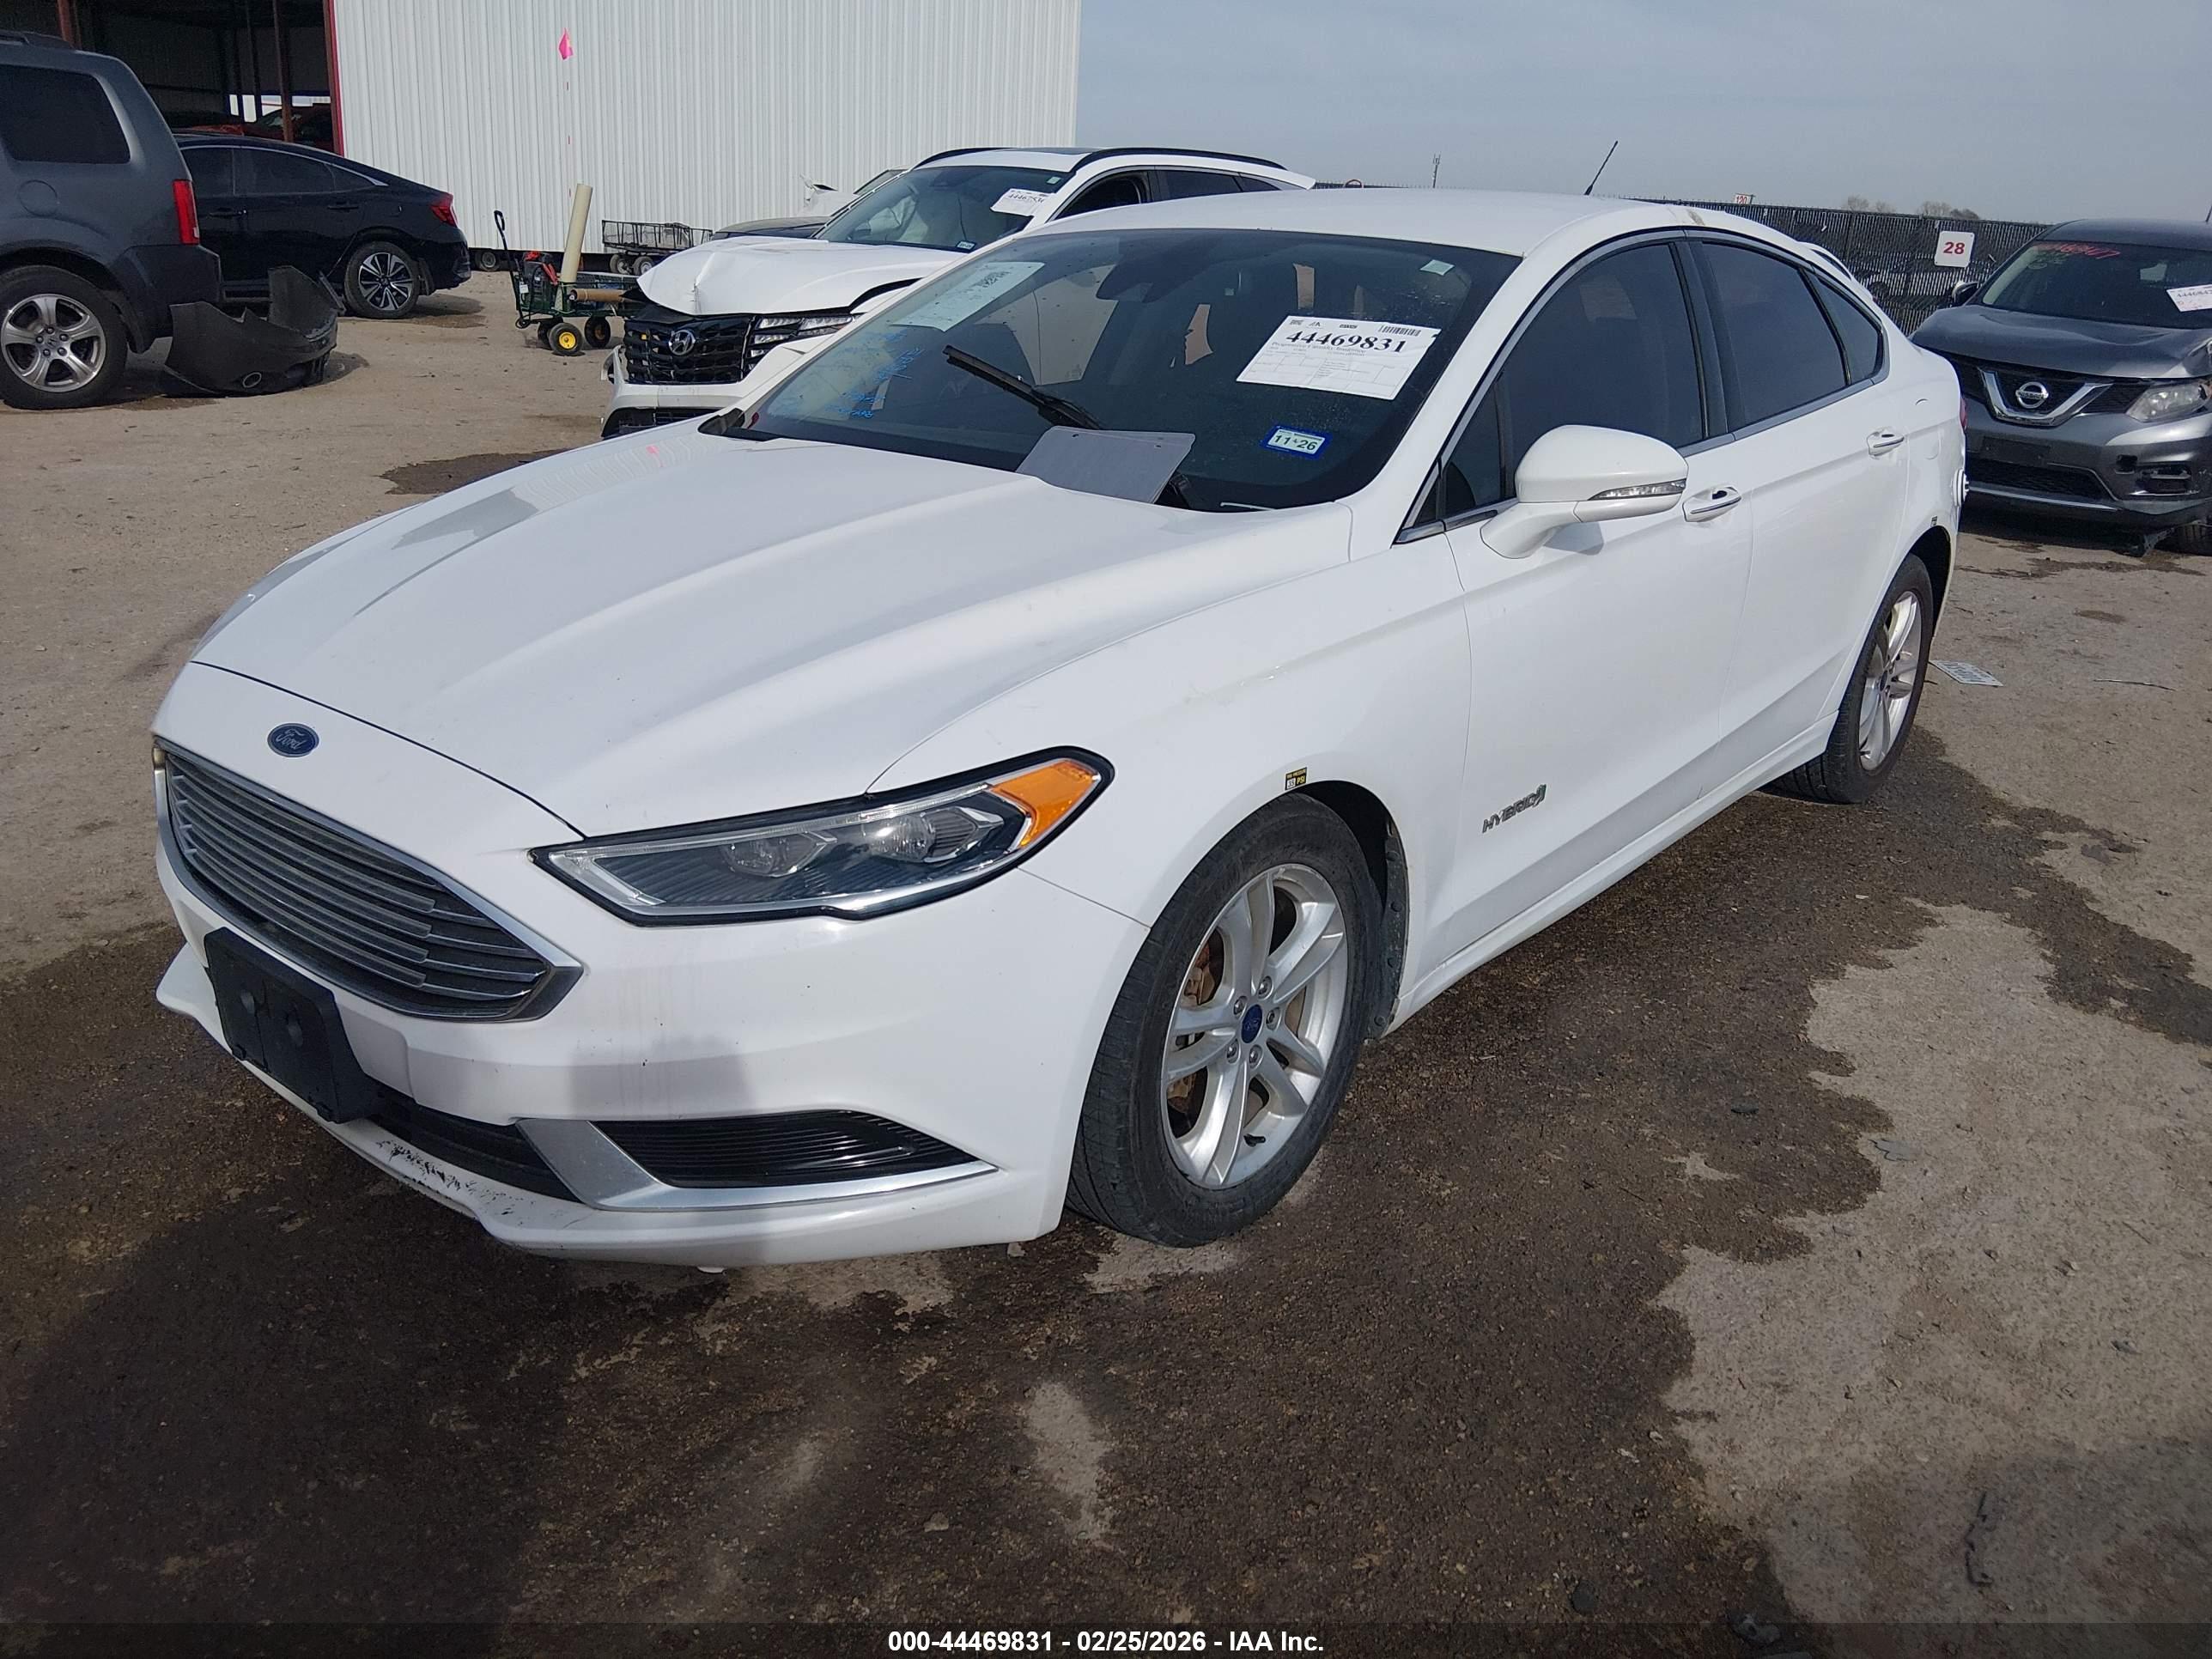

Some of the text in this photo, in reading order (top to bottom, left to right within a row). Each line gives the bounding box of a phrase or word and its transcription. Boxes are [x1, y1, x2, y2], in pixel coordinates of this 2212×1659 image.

[1943, 241, 1966, 255] 28
[1285, 331, 1407, 353] 44469831
[1275, 434, 1291, 446] 11
[1297, 440, 1318, 451] 26
[276, 728, 307, 750] Ford
[1297, 775, 1305, 785] PSI
[1482, 790, 1540, 834] HYBRID
